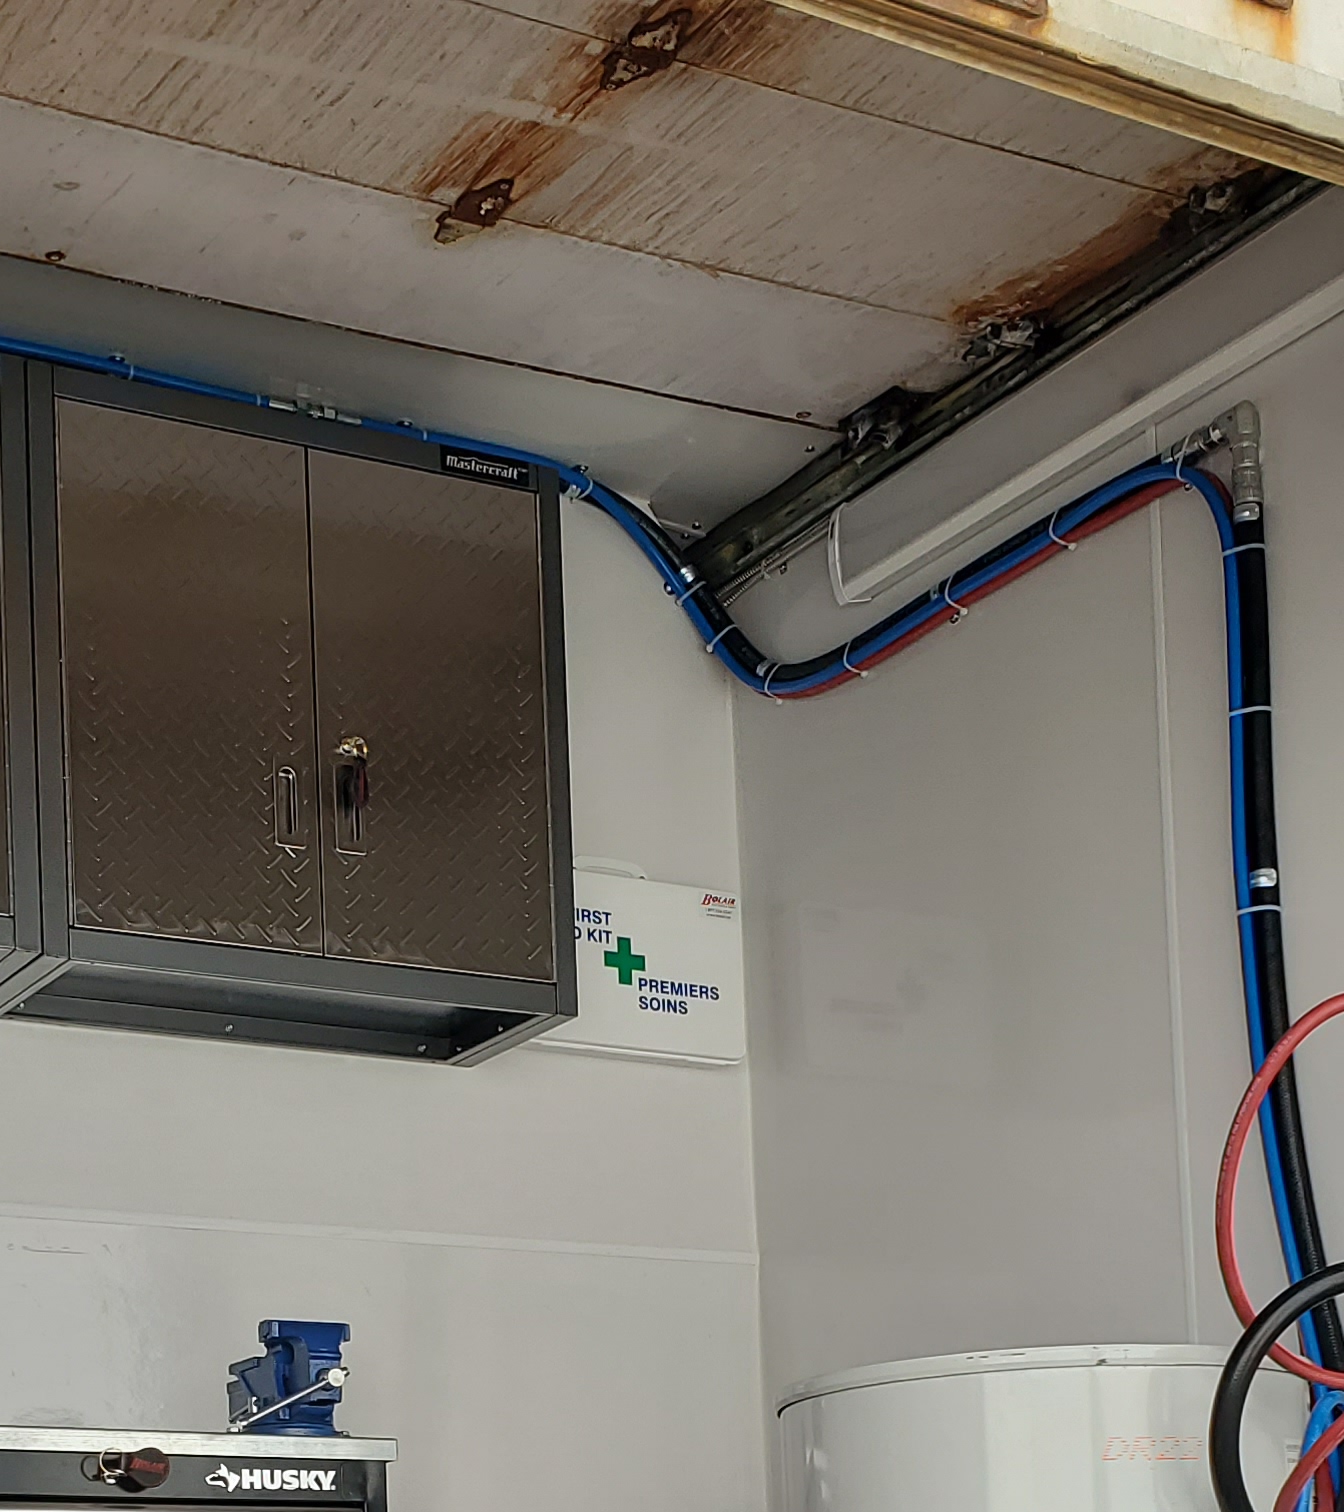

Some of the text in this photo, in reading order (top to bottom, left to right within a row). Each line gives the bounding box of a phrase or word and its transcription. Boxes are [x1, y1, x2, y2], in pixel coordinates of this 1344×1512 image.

[575, 908, 612, 925] IRST
[587, 928, 612, 944] KIT
[638, 977, 719, 1000] PREMIERS
[638, 996, 688, 1015] SOINS
[241, 1469, 336, 1490] HUSKY
